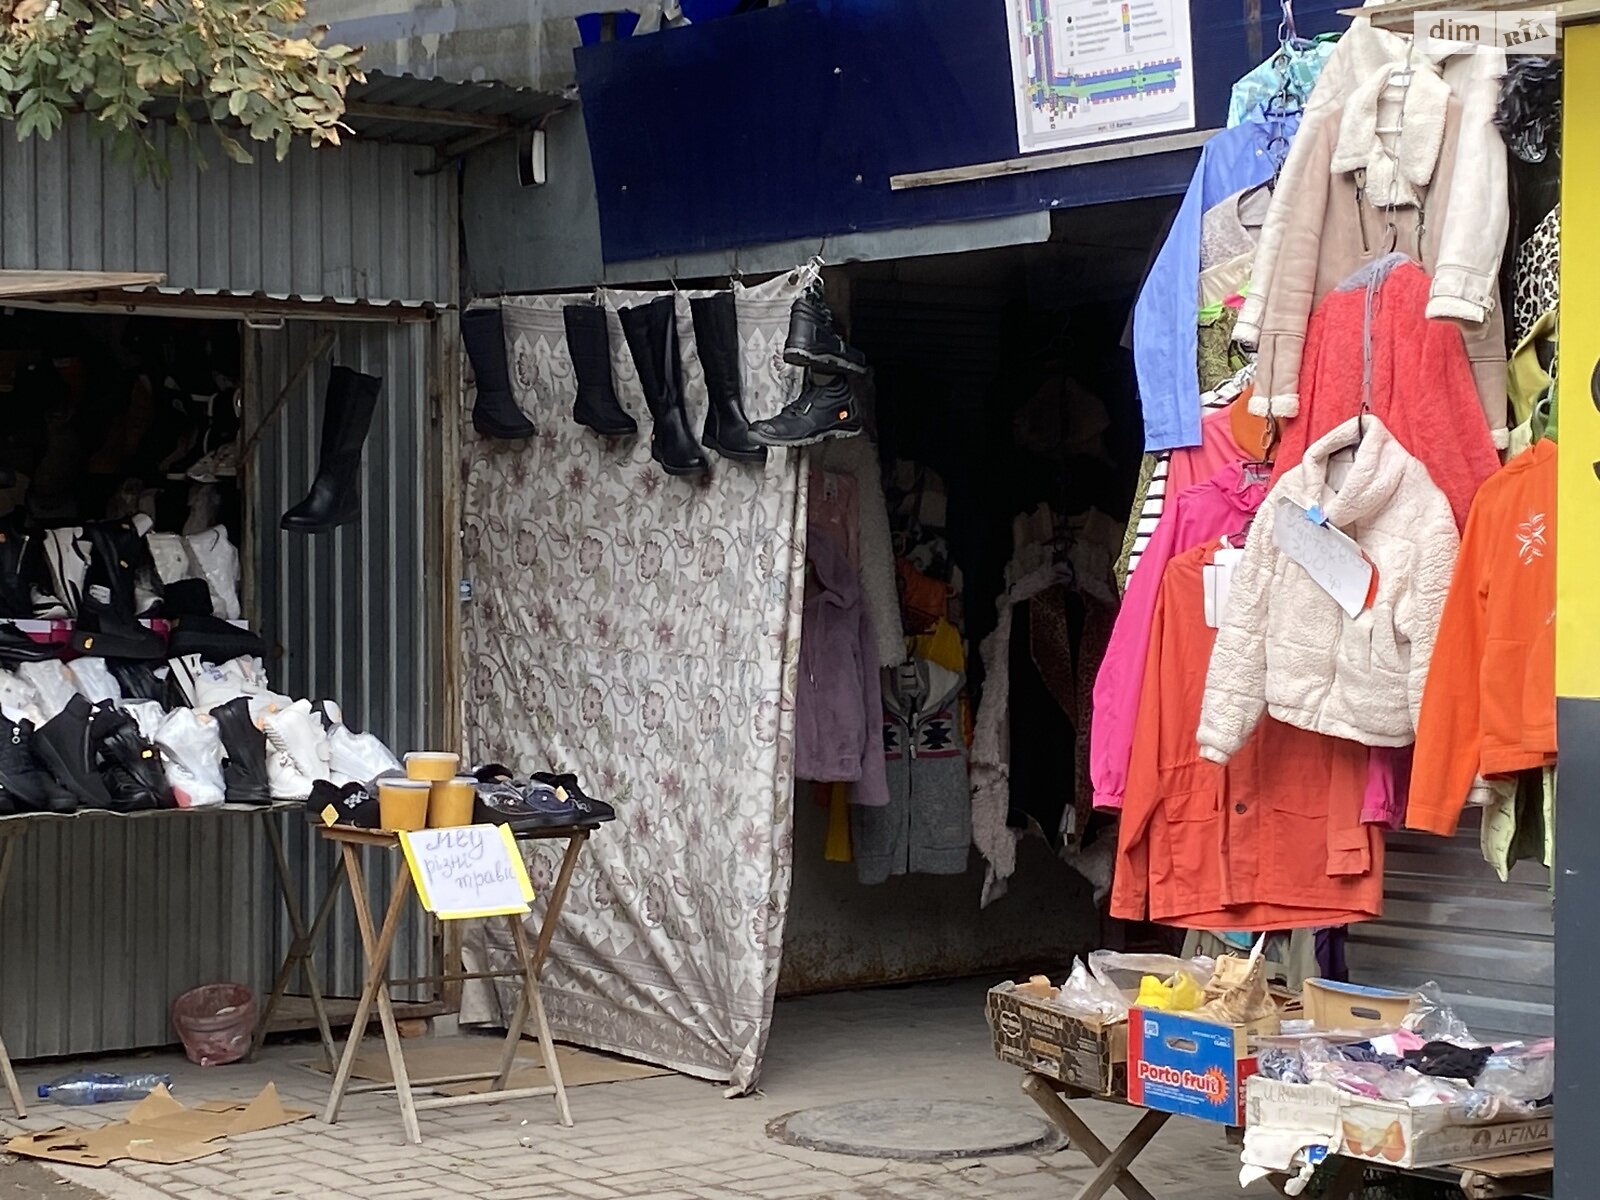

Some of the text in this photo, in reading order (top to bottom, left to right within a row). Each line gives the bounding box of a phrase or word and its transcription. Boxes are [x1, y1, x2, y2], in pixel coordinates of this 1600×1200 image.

[1138, 1060, 1180, 1087] Porto
[1182, 1070, 1219, 1095] fruit
[1495, 1123, 1549, 1145] AFINA
